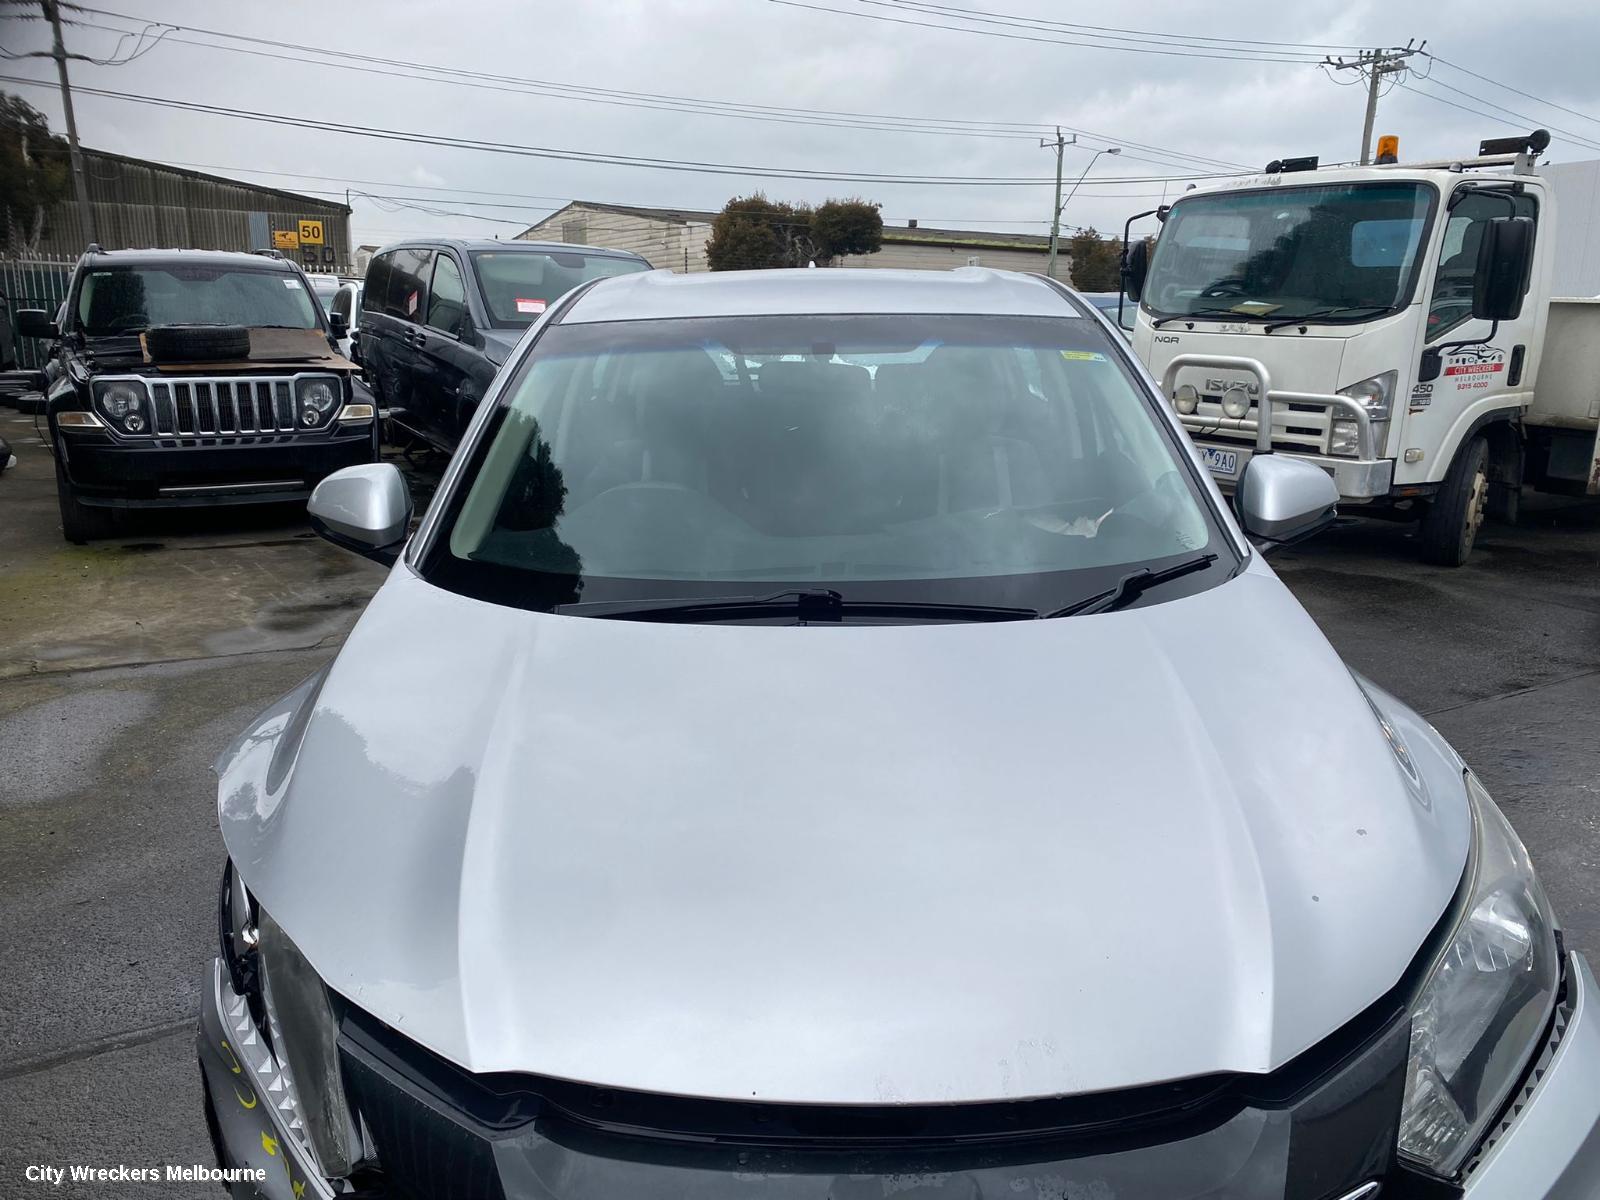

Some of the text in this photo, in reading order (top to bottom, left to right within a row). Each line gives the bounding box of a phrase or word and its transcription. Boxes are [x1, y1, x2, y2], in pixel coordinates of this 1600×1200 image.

[302, 225, 320, 239] 50
[302, 246, 335, 263] 50
[1154, 336, 1180, 344] NQR
[1454, 366, 1467, 375] CITY
[1455, 374, 1493, 382] MELBOURNE
[1205, 378, 1259, 394] ISUZU
[1412, 384, 1434, 393] 450
